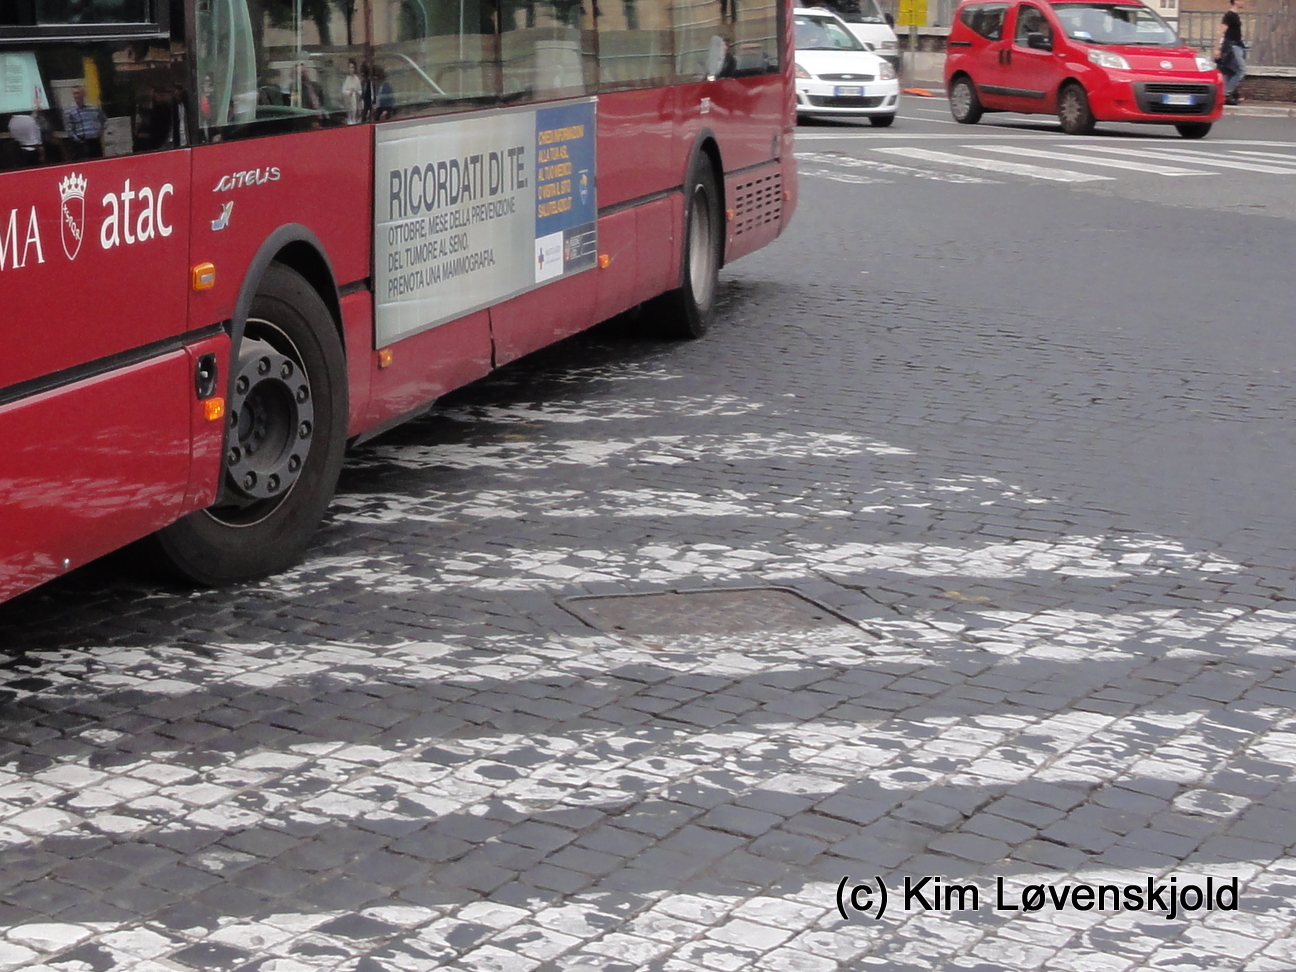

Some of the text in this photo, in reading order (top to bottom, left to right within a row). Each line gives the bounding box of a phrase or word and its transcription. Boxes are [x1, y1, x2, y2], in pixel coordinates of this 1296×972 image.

[389, 153, 484, 220] RICORDATI
[488, 150, 505, 197] DI
[507, 145, 529, 189] TE.
[100, 178, 174, 250] atac
[388, 219, 427, 246] OTTOBRE,
[428, 212, 448, 236] MESE
[449, 207, 471, 231] DELLA
[471, 196, 516, 225] PREVENZIONE
[388, 250, 403, 273] DEL
[405, 240, 438, 268] TUMORE
[438, 238, 448, 258] AL
[388, 269, 424, 298] PRENOTA
[425, 264, 441, 286] UNA
